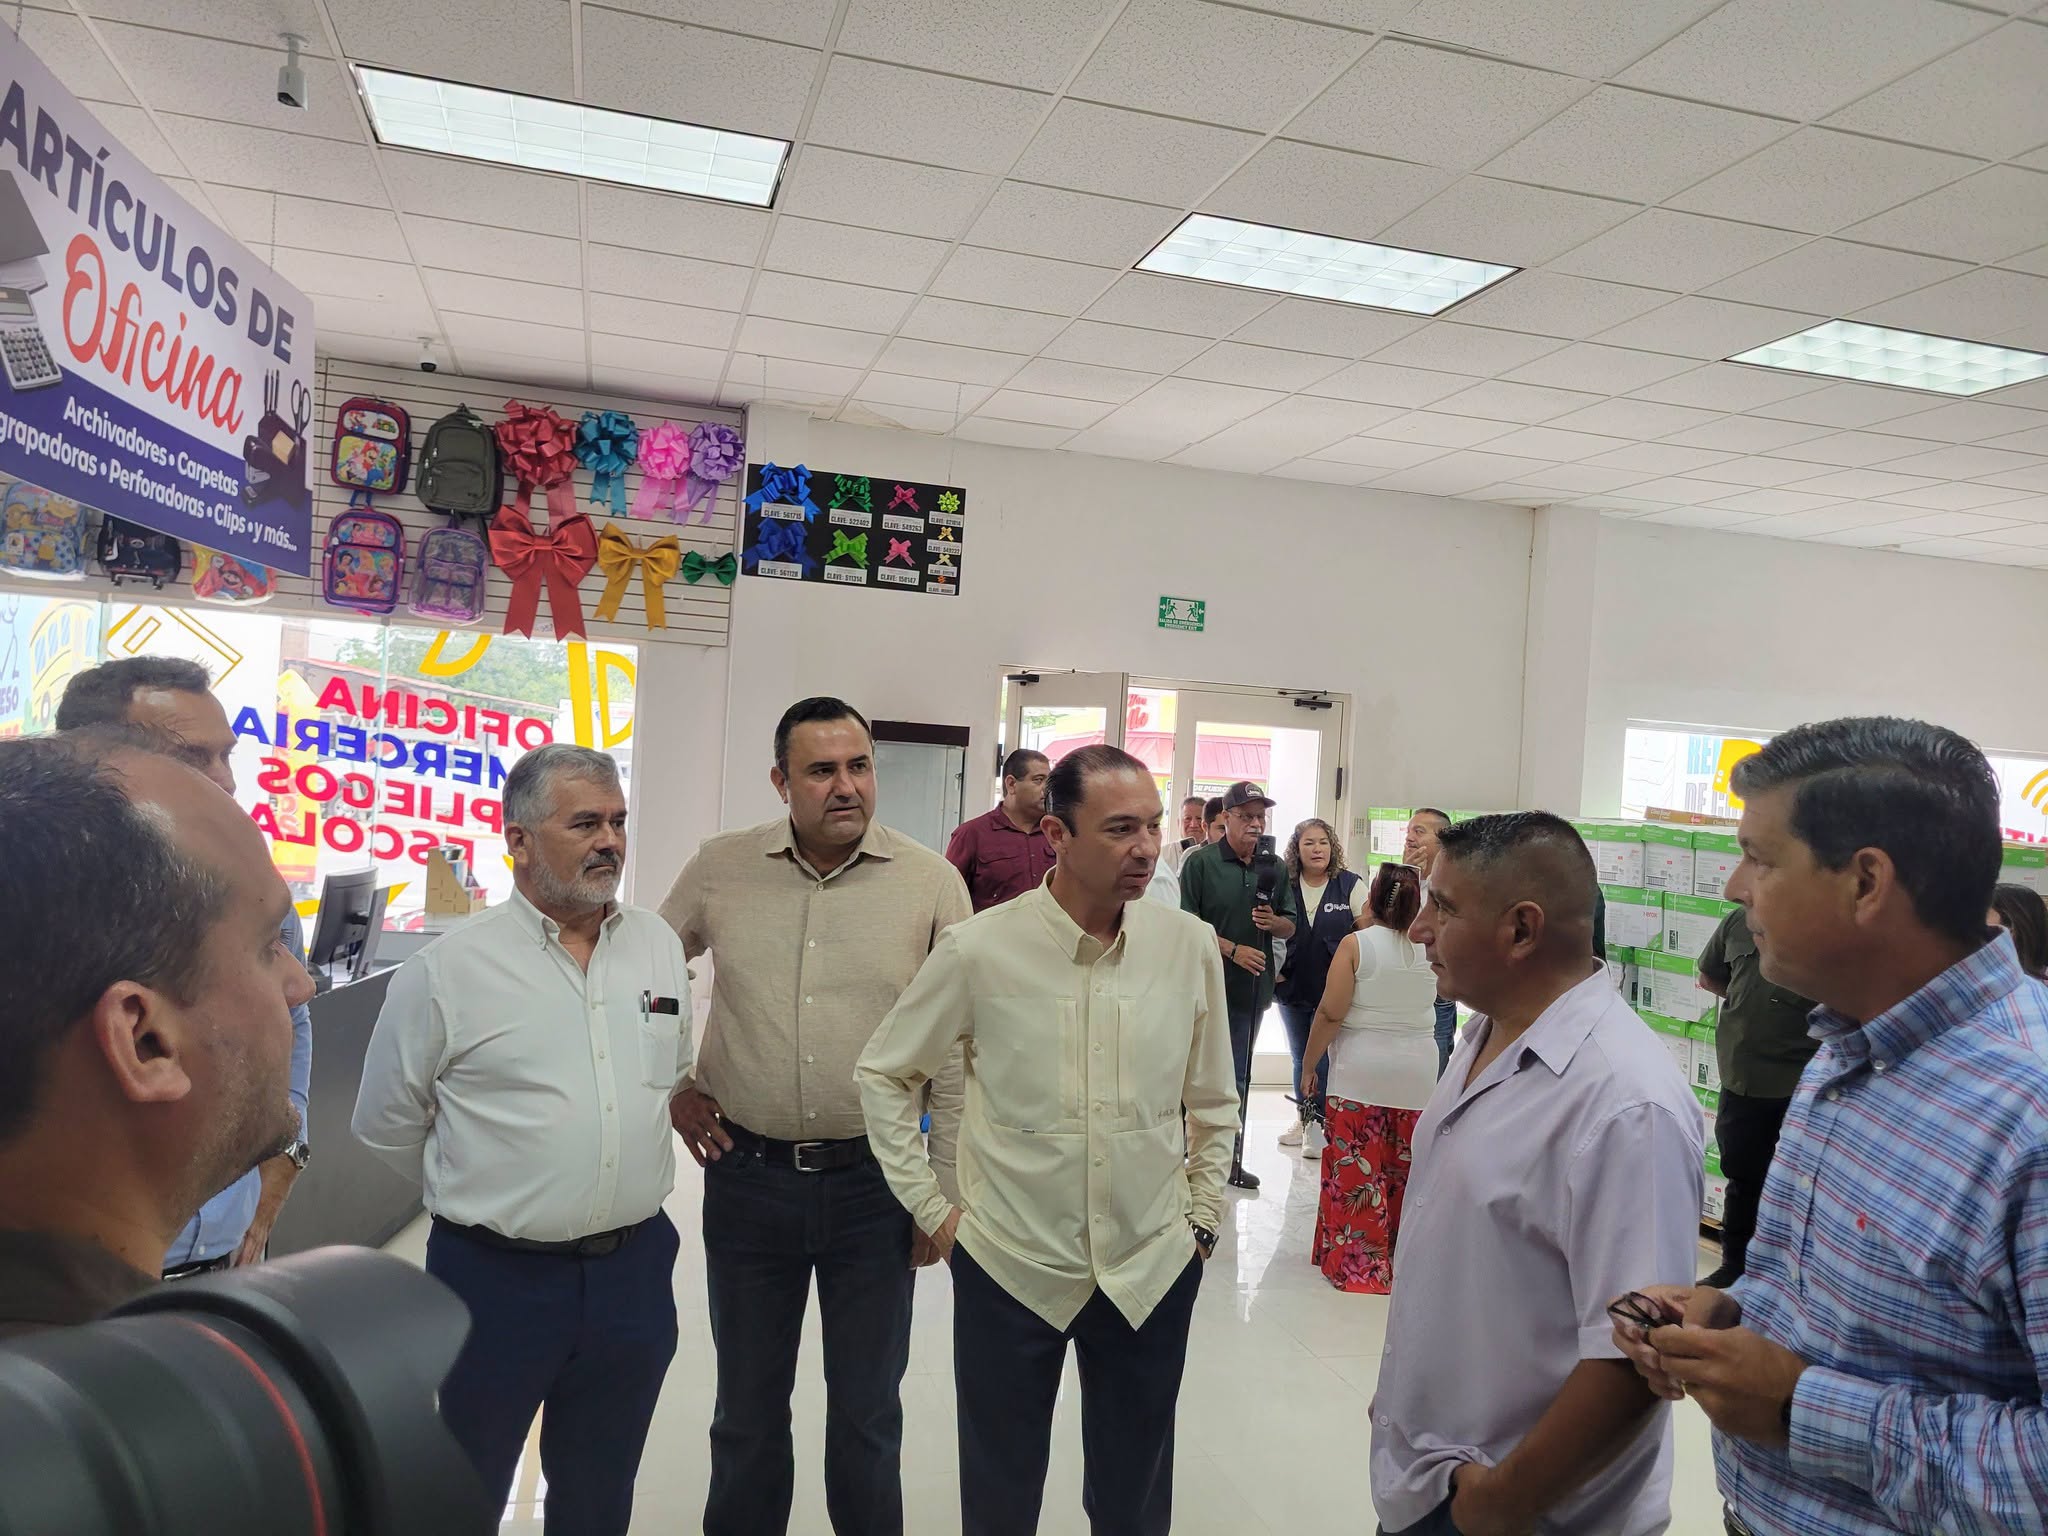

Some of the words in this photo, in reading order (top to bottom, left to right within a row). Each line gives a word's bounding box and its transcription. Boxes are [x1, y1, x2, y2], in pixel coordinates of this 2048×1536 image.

[0, 80, 239, 326] ARTÍCULOS
[248, 287, 295, 364] DE
[63, 233, 244, 435] Oficina
[63, 396, 167, 466] Archivadores
[177, 451, 239, 496] Carpetas
[109, 458, 205, 518] Perforadoras
[214, 503, 246, 535] Clips
[252, 521, 263, 543] y
